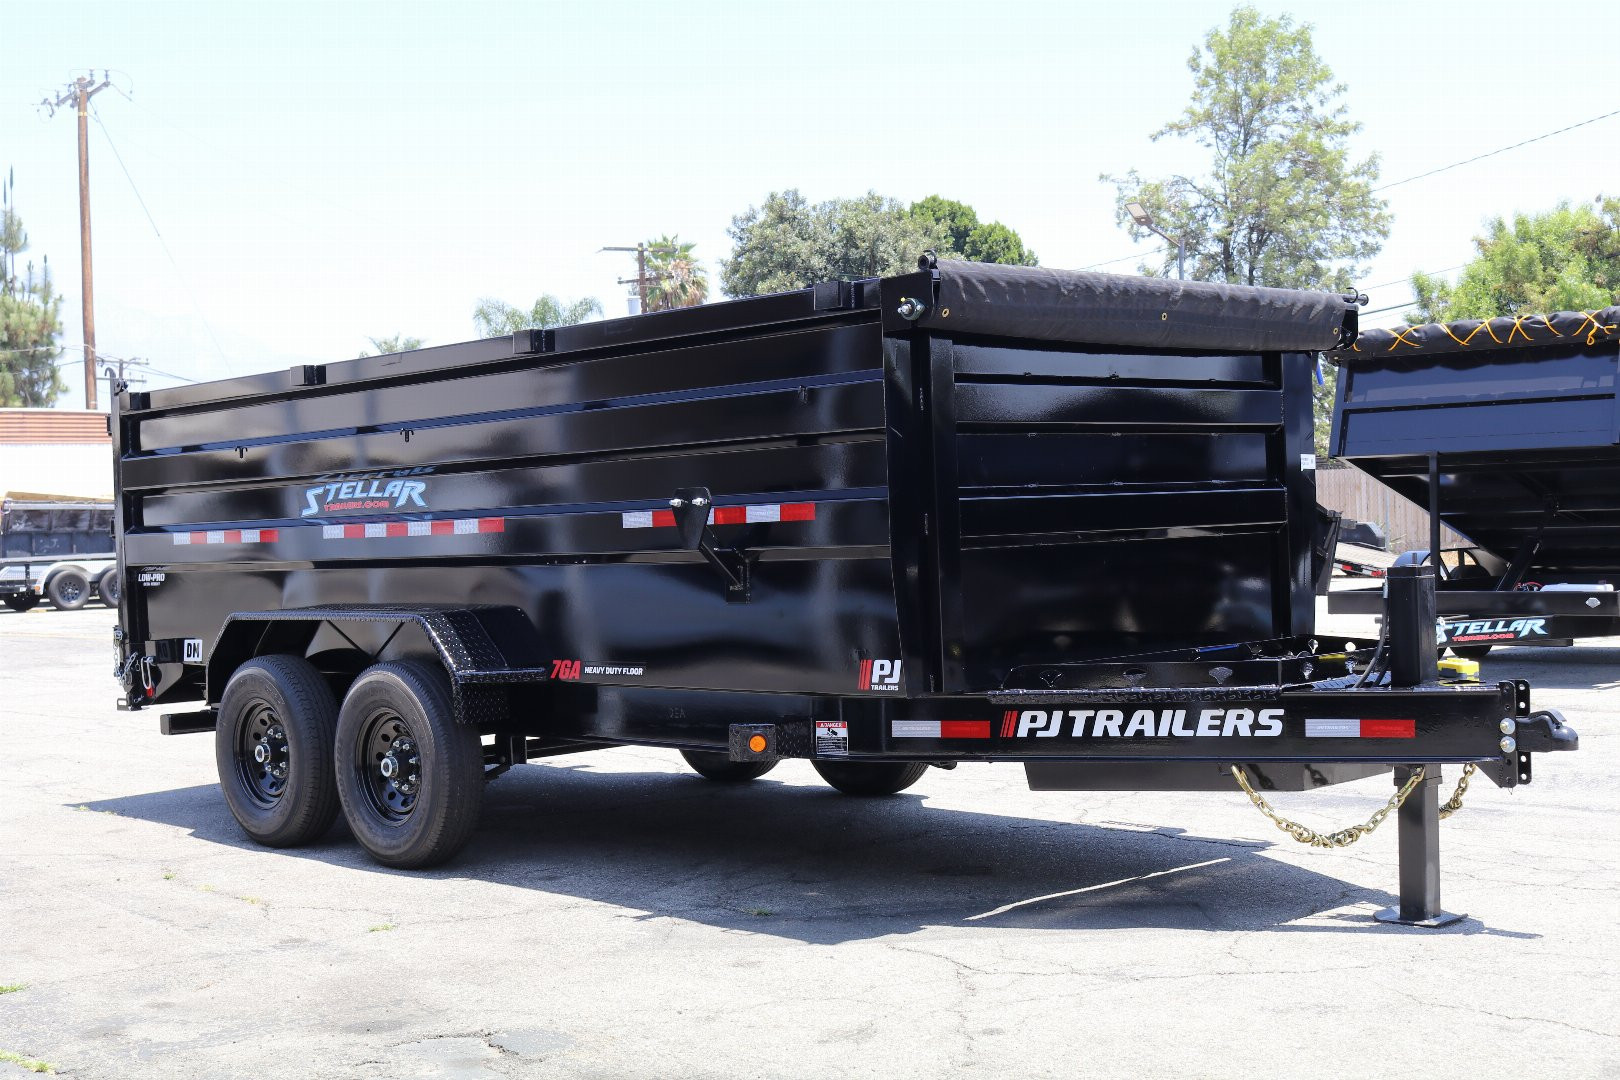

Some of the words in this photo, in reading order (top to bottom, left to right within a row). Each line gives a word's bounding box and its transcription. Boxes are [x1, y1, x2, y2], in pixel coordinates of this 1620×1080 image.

[301, 480, 428, 517] STELLAR
[138, 573, 165, 582] LOW-PRO
[1436, 618, 1548, 644] STELLAR
[186, 642, 200, 658] DN
[550, 660, 581, 680] 7GA
[584, 666, 605, 674] HEAVY
[605, 667, 622, 675] DUTY
[622, 667, 644, 676] FLOOR
[872, 660, 901, 683] PJ
[1016, 710, 1063, 737] PJ
[1069, 708, 1285, 737] TRAILERS
